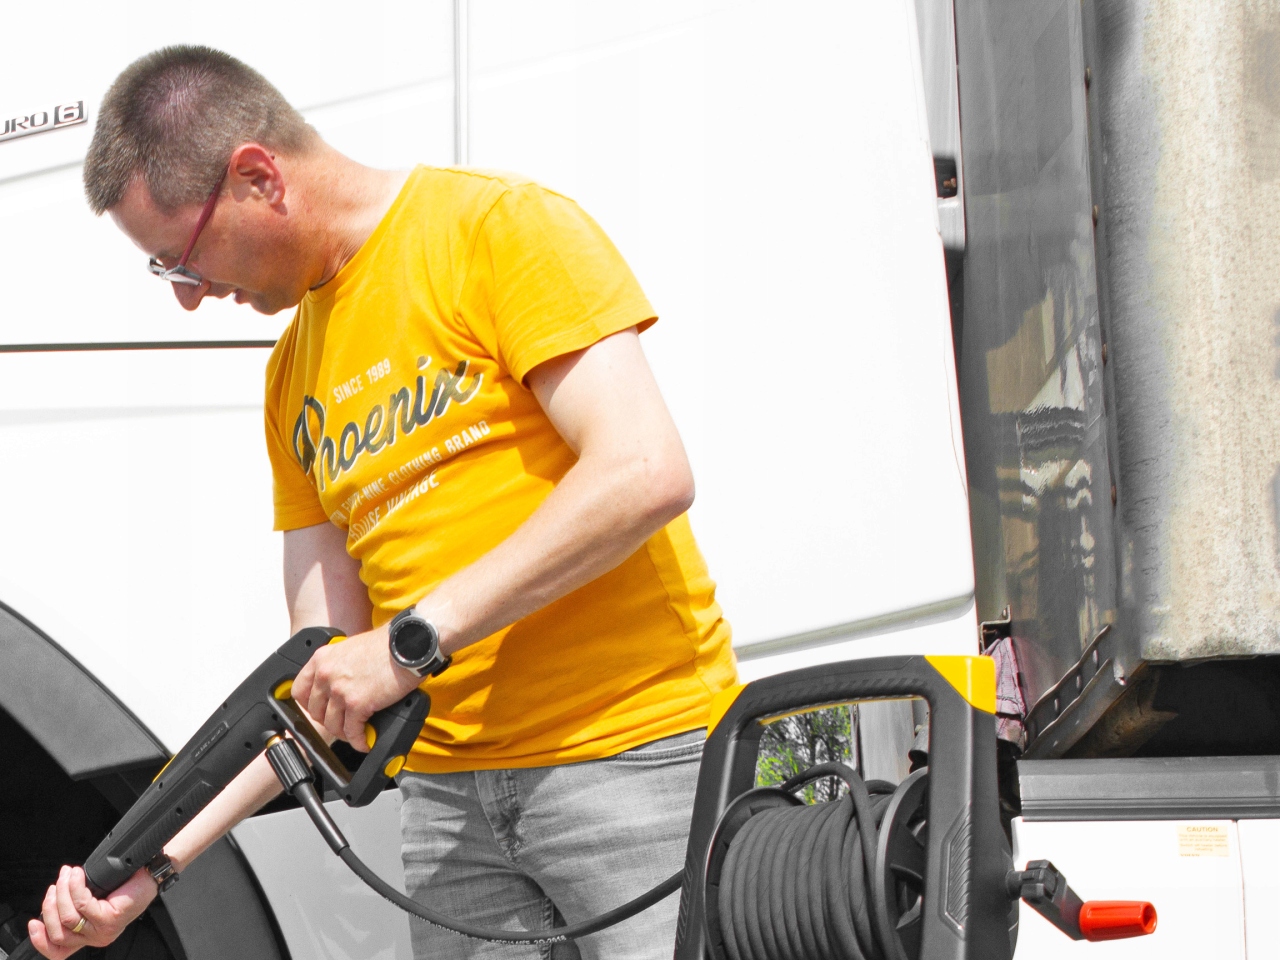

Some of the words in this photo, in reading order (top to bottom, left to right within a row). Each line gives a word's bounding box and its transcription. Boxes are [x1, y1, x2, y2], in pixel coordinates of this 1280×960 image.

[333, 374, 364, 404] SINCE
[366, 358, 391, 384] 1989
[292, 355, 484, 492] Phoenix
[388, 447, 443, 485] CLOTHING
[445, 421, 491, 453] BRAND
